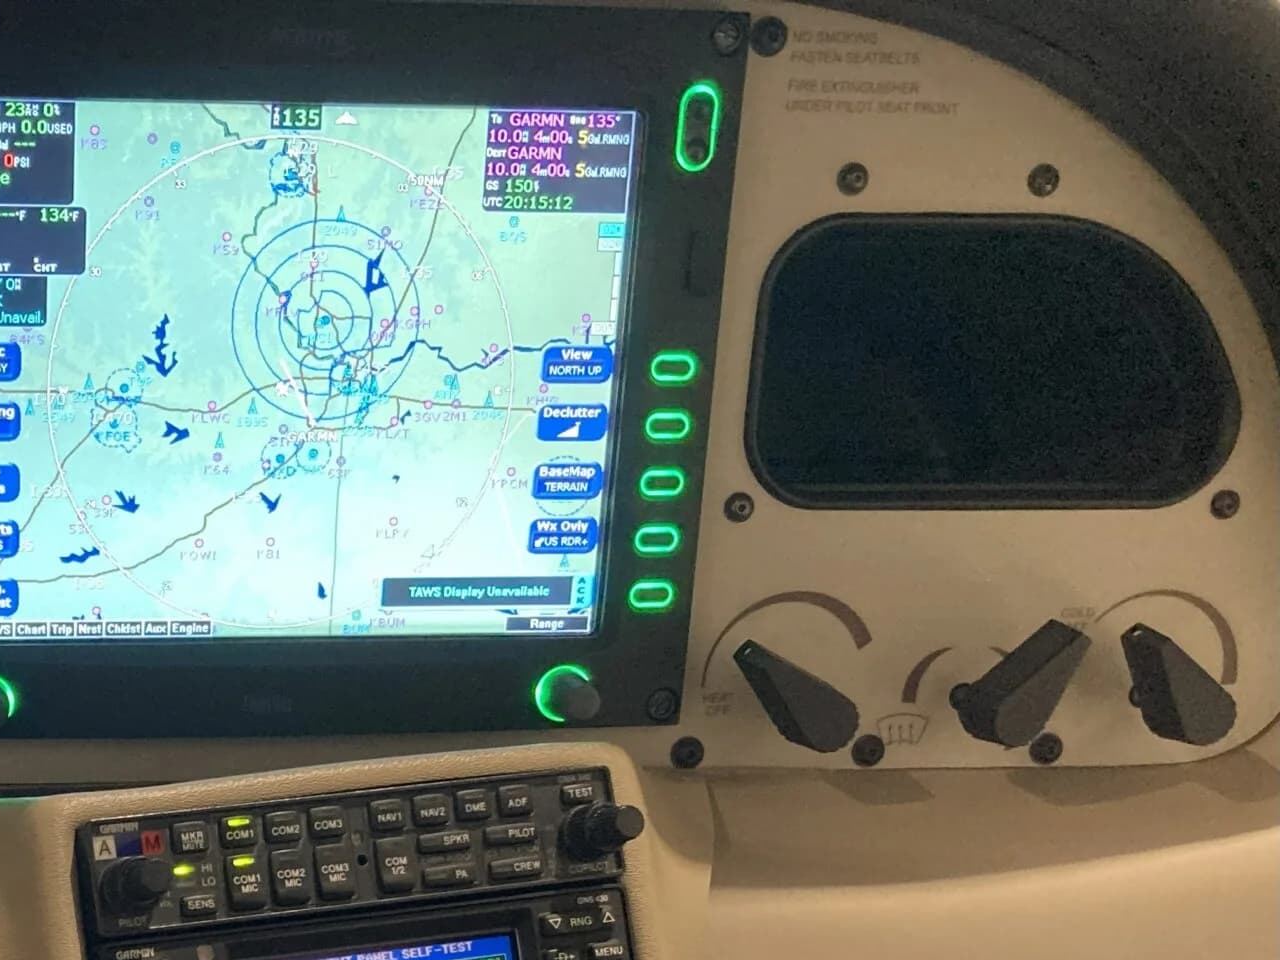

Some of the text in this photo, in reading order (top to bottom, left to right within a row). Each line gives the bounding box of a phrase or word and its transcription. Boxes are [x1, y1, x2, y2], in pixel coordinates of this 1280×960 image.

[283, 110, 320, 126] 135
[510, 114, 564, 126] GARMN
[484, 196, 573, 210] UTC 20:15:12
[561, 349, 592, 360] View
[549, 365, 601, 376] NORTH UP
[543, 408, 601, 418] Declutter
[540, 466, 595, 478] BaseMap
[545, 482, 587, 492] TERRAIN
[409, 587, 440, 597] TAWS
[444, 587, 484, 599] Display
[17, 624, 46, 634] Chart
[52, 624, 72, 636] Trip
[78, 623, 101, 633] Nrst
[145, 623, 166, 633] Aux
[172, 623, 209, 635] Engine
[568, 787, 592, 797] TEST
[421, 807, 445, 818] NAV2
[465, 802, 486, 813] DME
[378, 812, 402, 822] NAV1
[272, 825, 300, 836] COM2
[314, 819, 342, 831] COM3
[226, 829, 254, 840] COM1
[508, 827, 536, 838] PILOT
[514, 860, 541, 871] CREW
[117, 948, 154, 960] GARMIN
[596, 946, 623, 957] MENU
